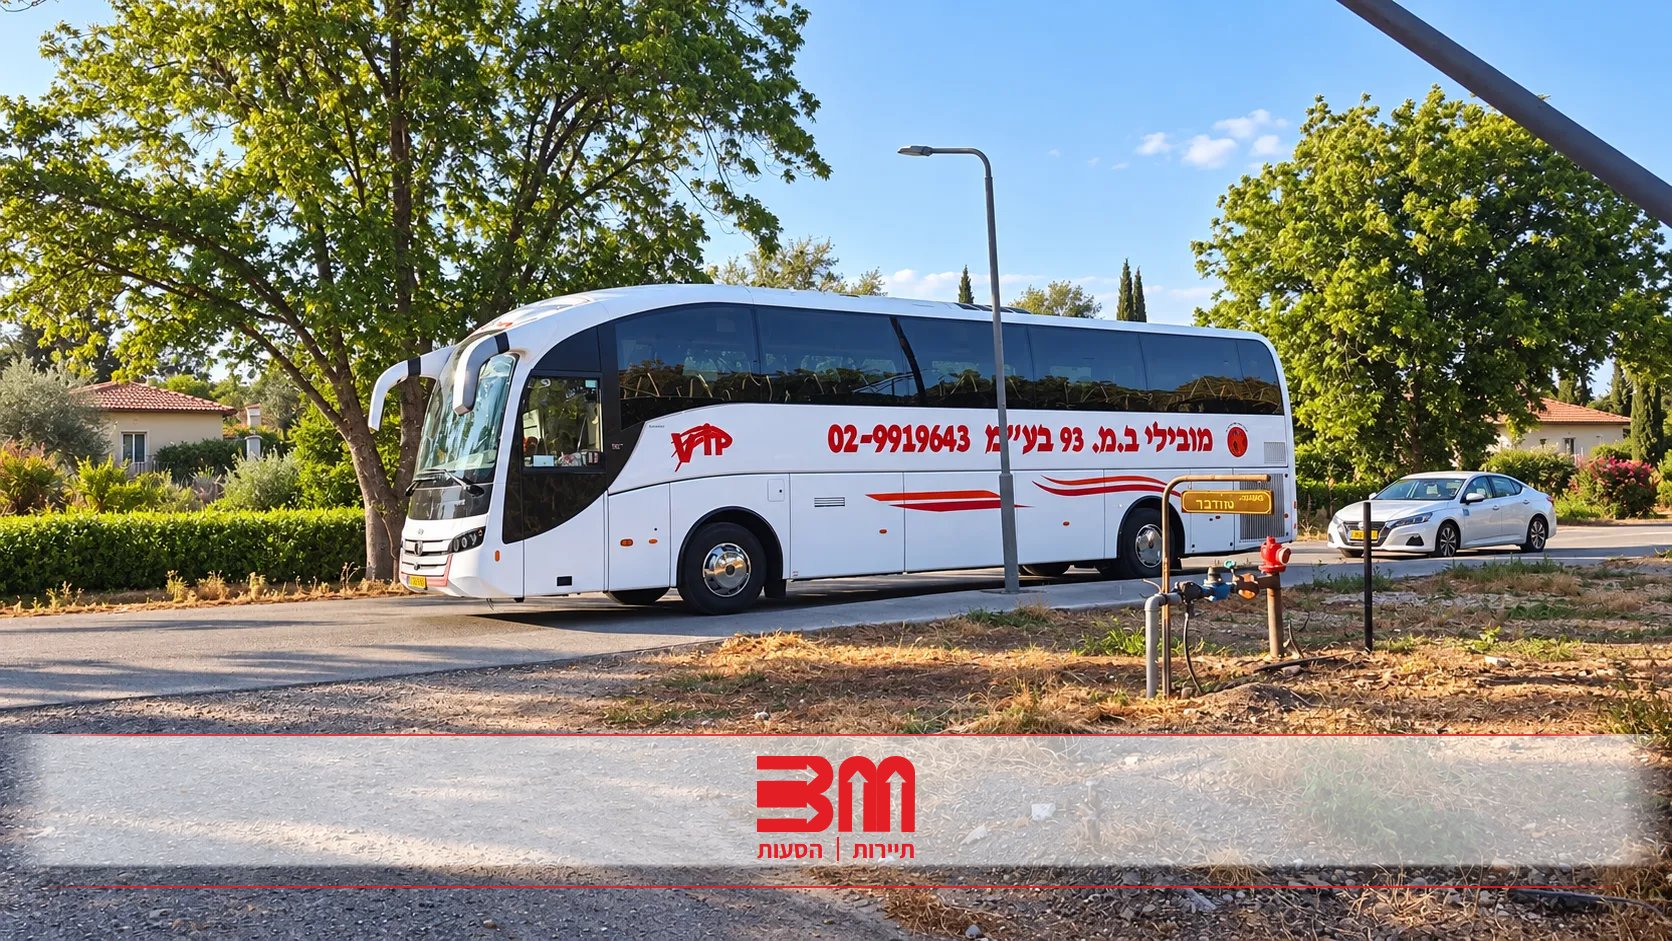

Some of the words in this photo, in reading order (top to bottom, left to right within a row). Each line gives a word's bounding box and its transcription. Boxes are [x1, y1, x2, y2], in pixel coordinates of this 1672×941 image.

[828, 424, 970, 452] 02-9919643
[1060, 427, 1084, 452] 93
[1092, 426, 1140, 453] ב.מ.
[1145, 422, 1213, 452] מובילי
